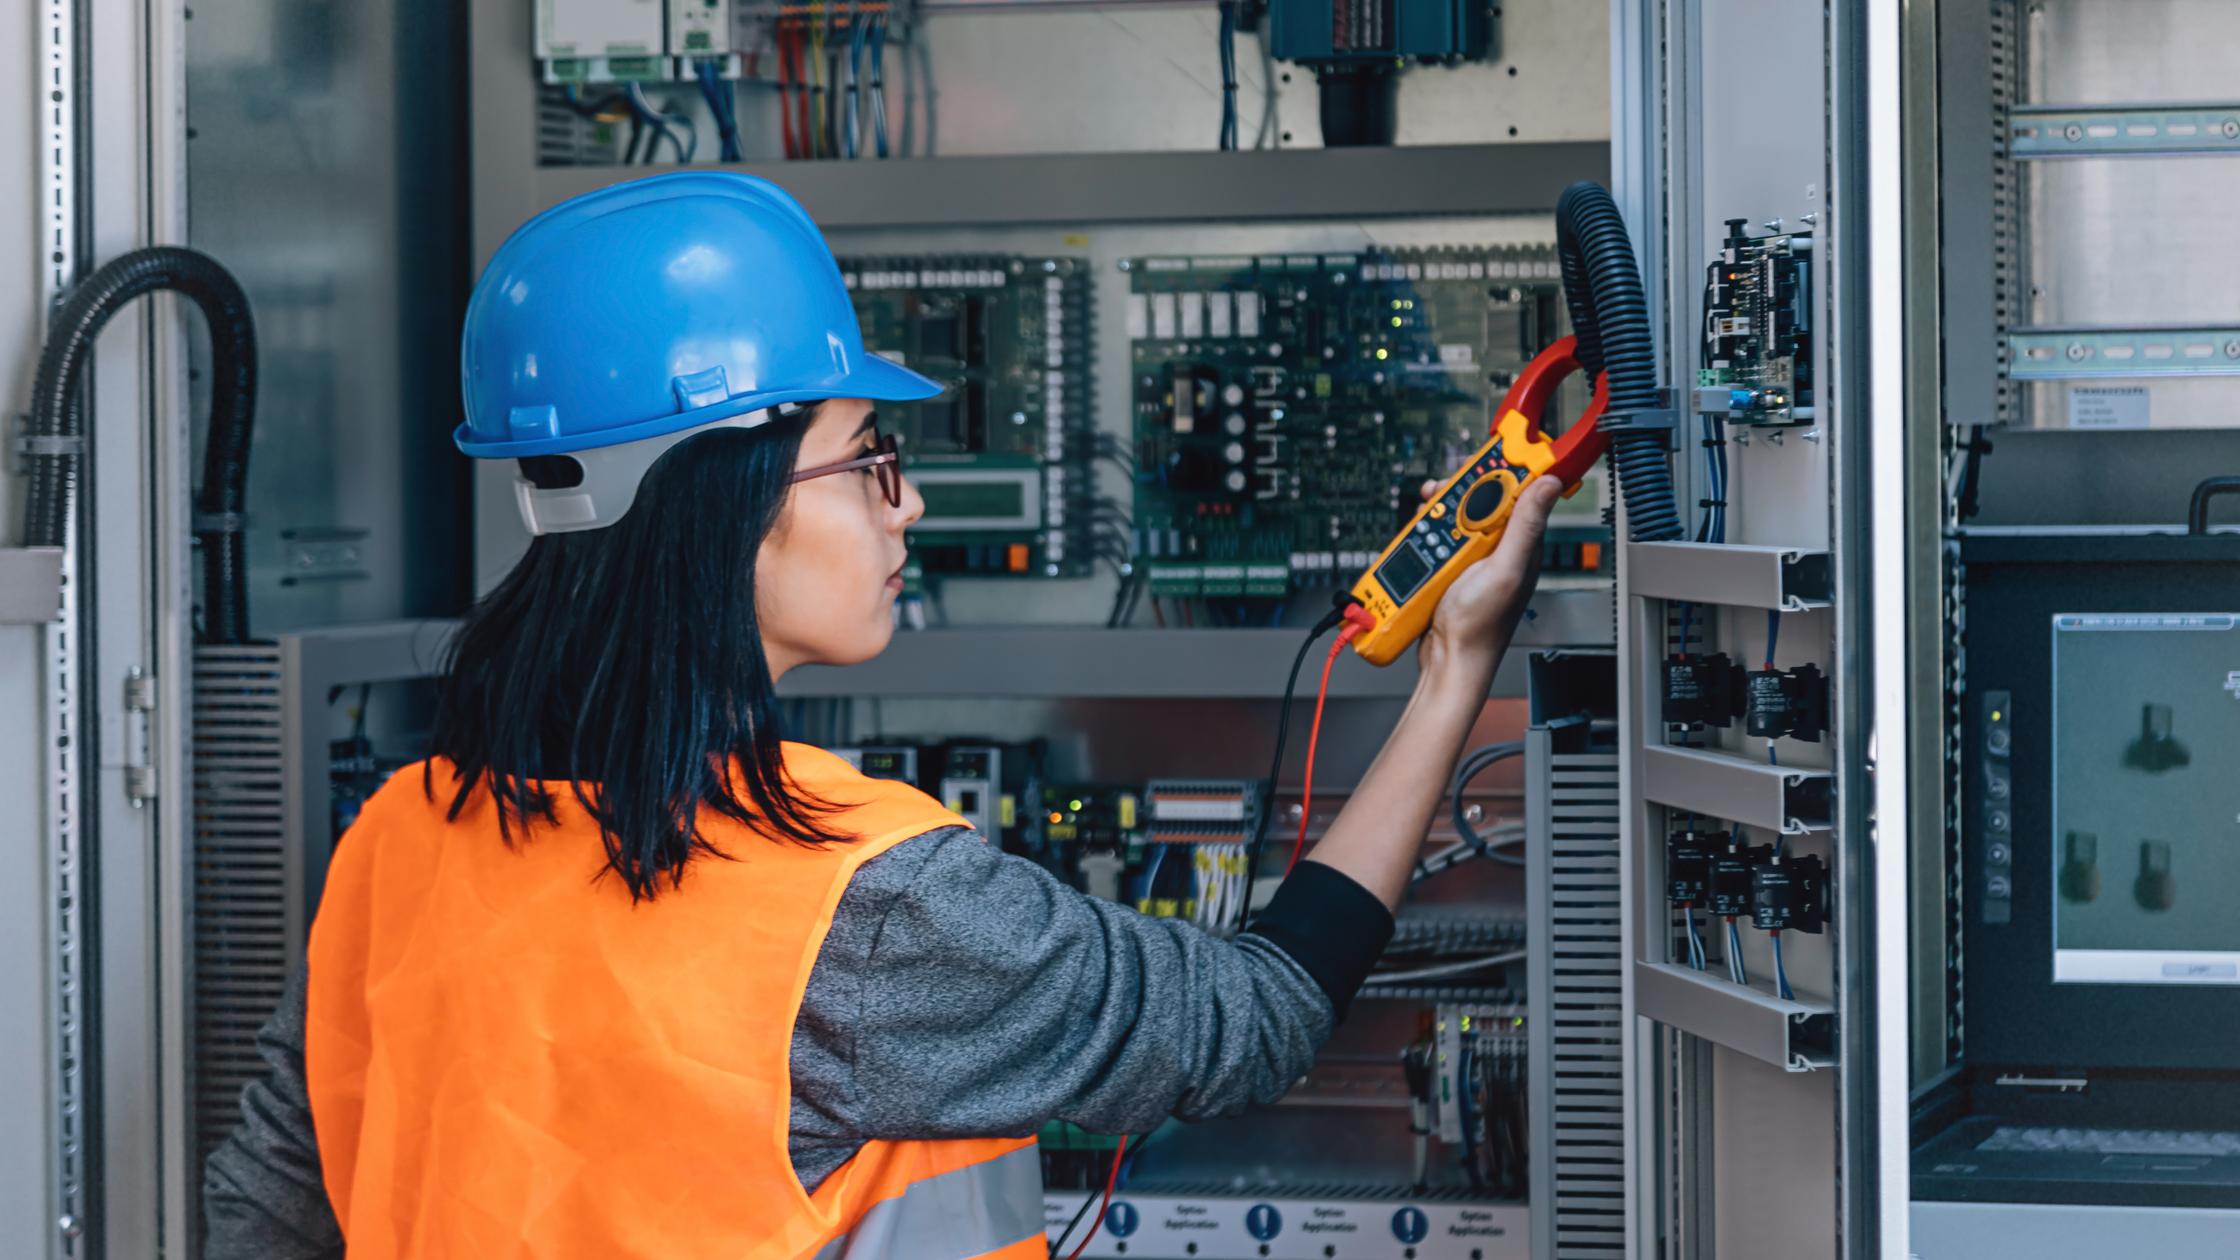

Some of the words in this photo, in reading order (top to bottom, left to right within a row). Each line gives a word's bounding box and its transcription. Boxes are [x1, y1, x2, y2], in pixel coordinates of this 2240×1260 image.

[1460, 1211, 1492, 1222] Option
[1165, 1219, 1219, 1230] Application
[1302, 1221, 1357, 1233] Application
[1449, 1224, 1505, 1237] Application
